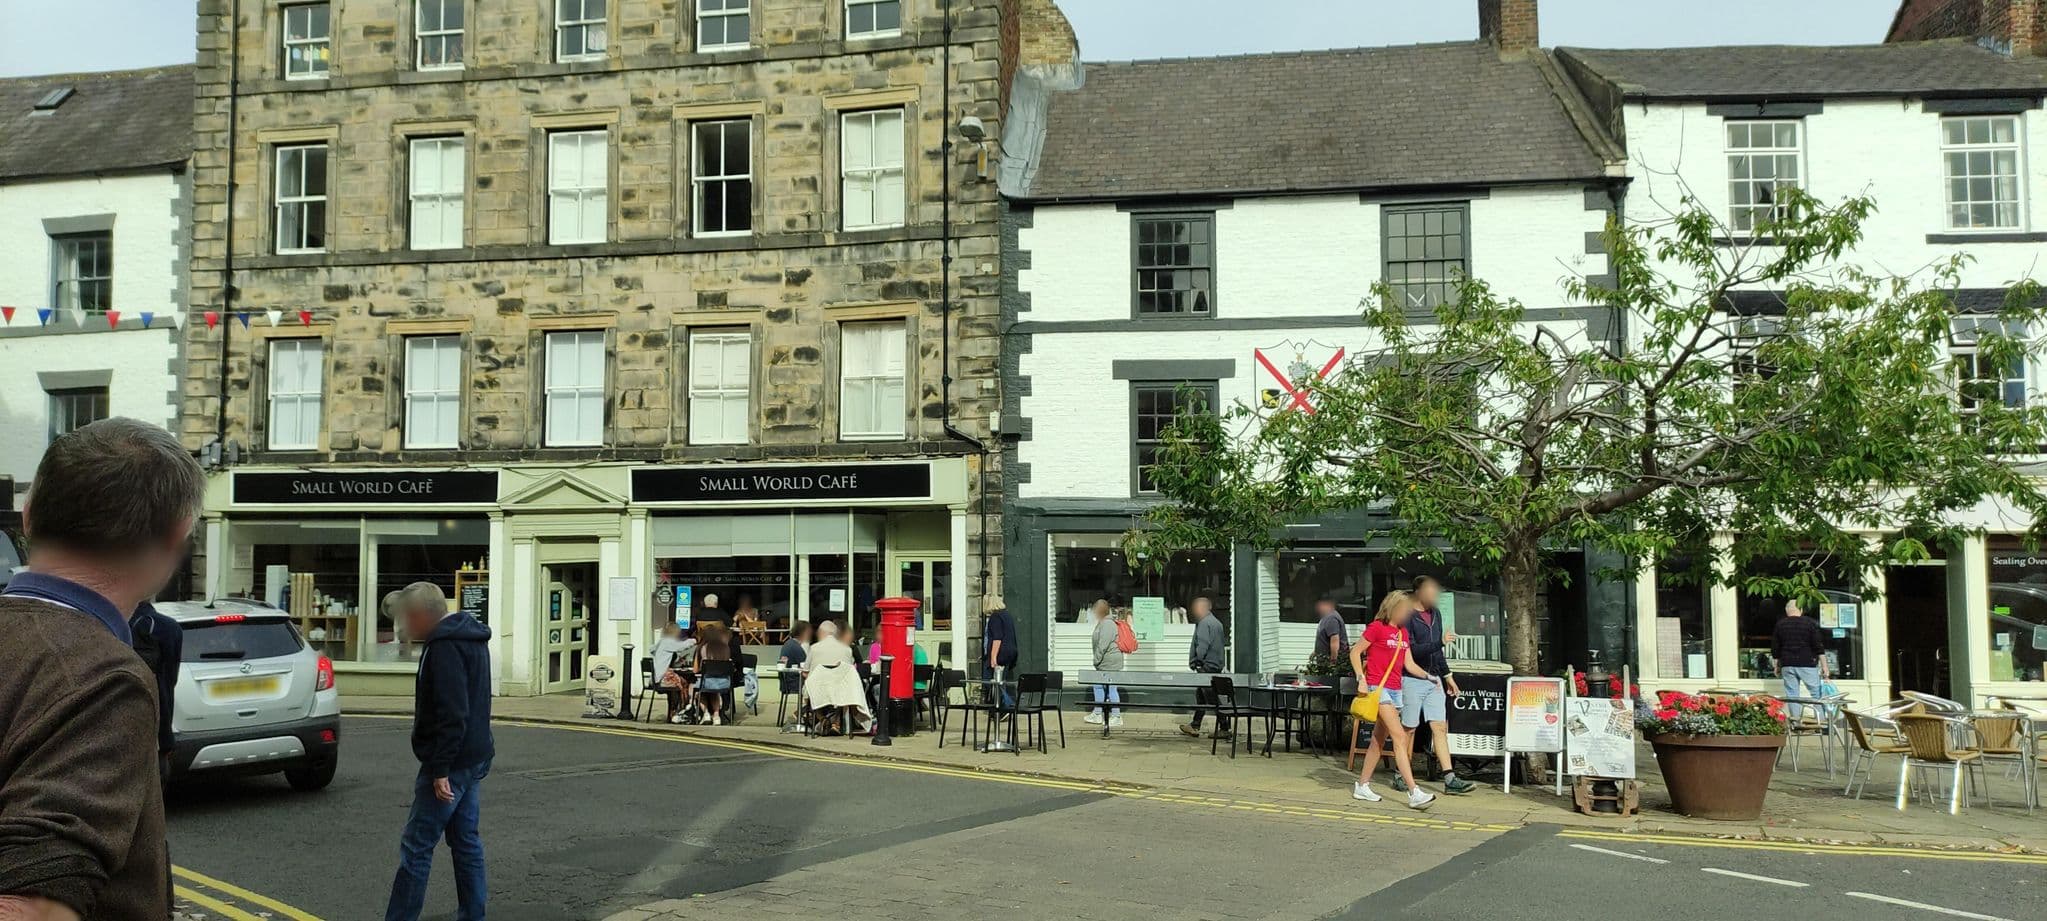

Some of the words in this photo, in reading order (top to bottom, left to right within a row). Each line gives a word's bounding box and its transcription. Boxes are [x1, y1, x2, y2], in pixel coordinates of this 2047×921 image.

[292, 480, 336, 494] SMALL
[339, 480, 394, 494] WORLD
[699, 476, 748, 491] SMALL
[752, 475, 813, 491] WORLD
[818, 473, 857, 489] CAFÉ
[1993, 556, 2026, 567] Seating
[1453, 696, 1505, 711] CAFE
